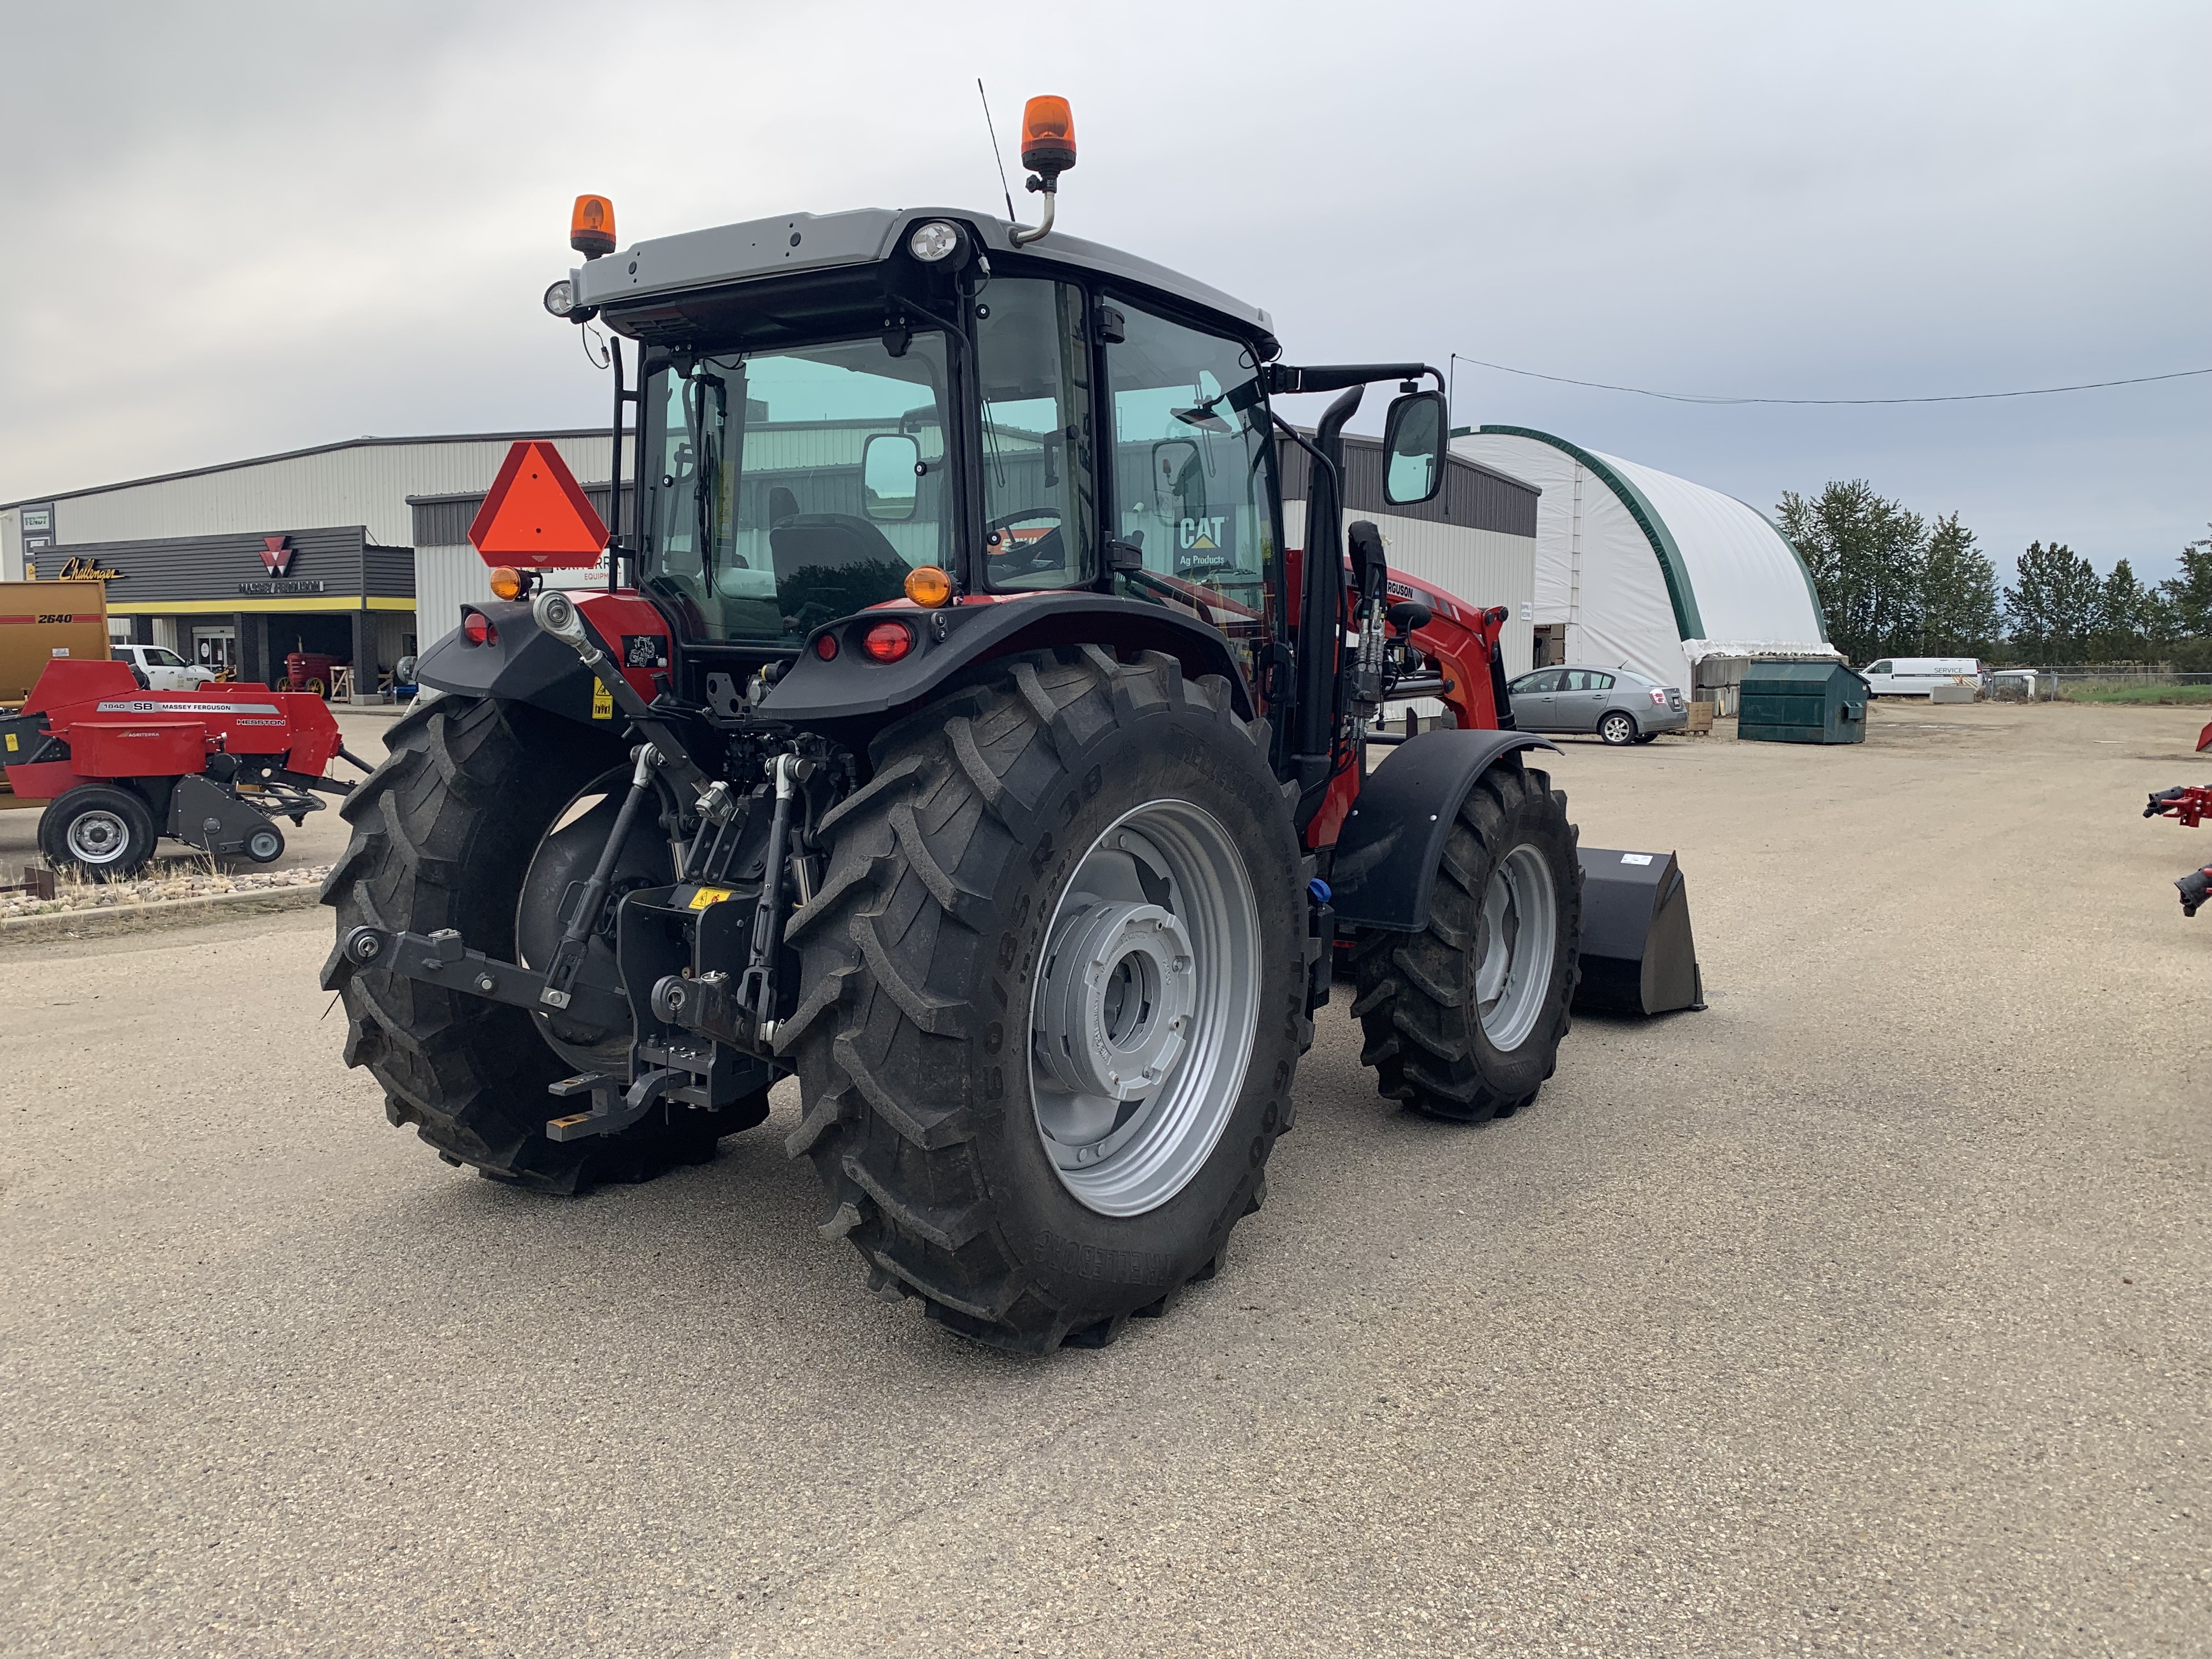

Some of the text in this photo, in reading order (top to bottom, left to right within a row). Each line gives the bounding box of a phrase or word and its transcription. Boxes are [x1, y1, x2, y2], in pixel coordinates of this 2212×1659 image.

[25, 516, 47, 526] FENDT
[1180, 555, 1224, 566] Ag Products
[38, 614, 72, 624] 2640
